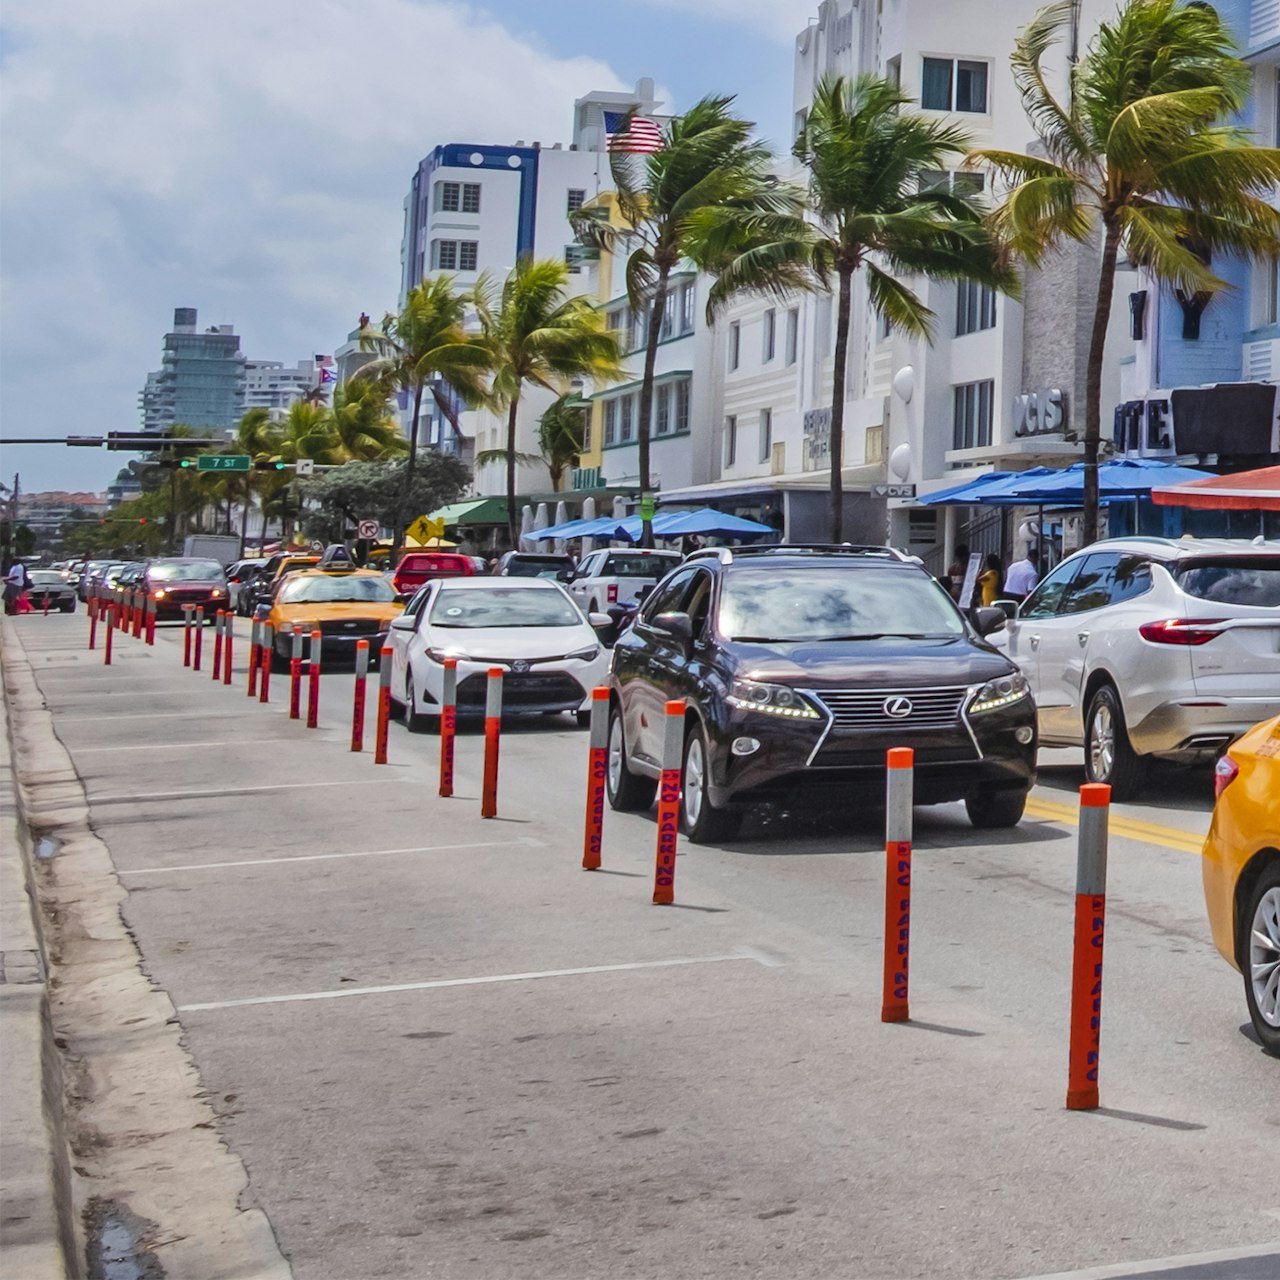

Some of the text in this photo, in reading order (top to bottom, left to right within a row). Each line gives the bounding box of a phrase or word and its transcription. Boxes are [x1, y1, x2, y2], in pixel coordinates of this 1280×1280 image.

[213, 458, 236, 467] 7 ST
[888, 486, 912, 497] CVS
[657, 783, 679, 887] NO PARKING
